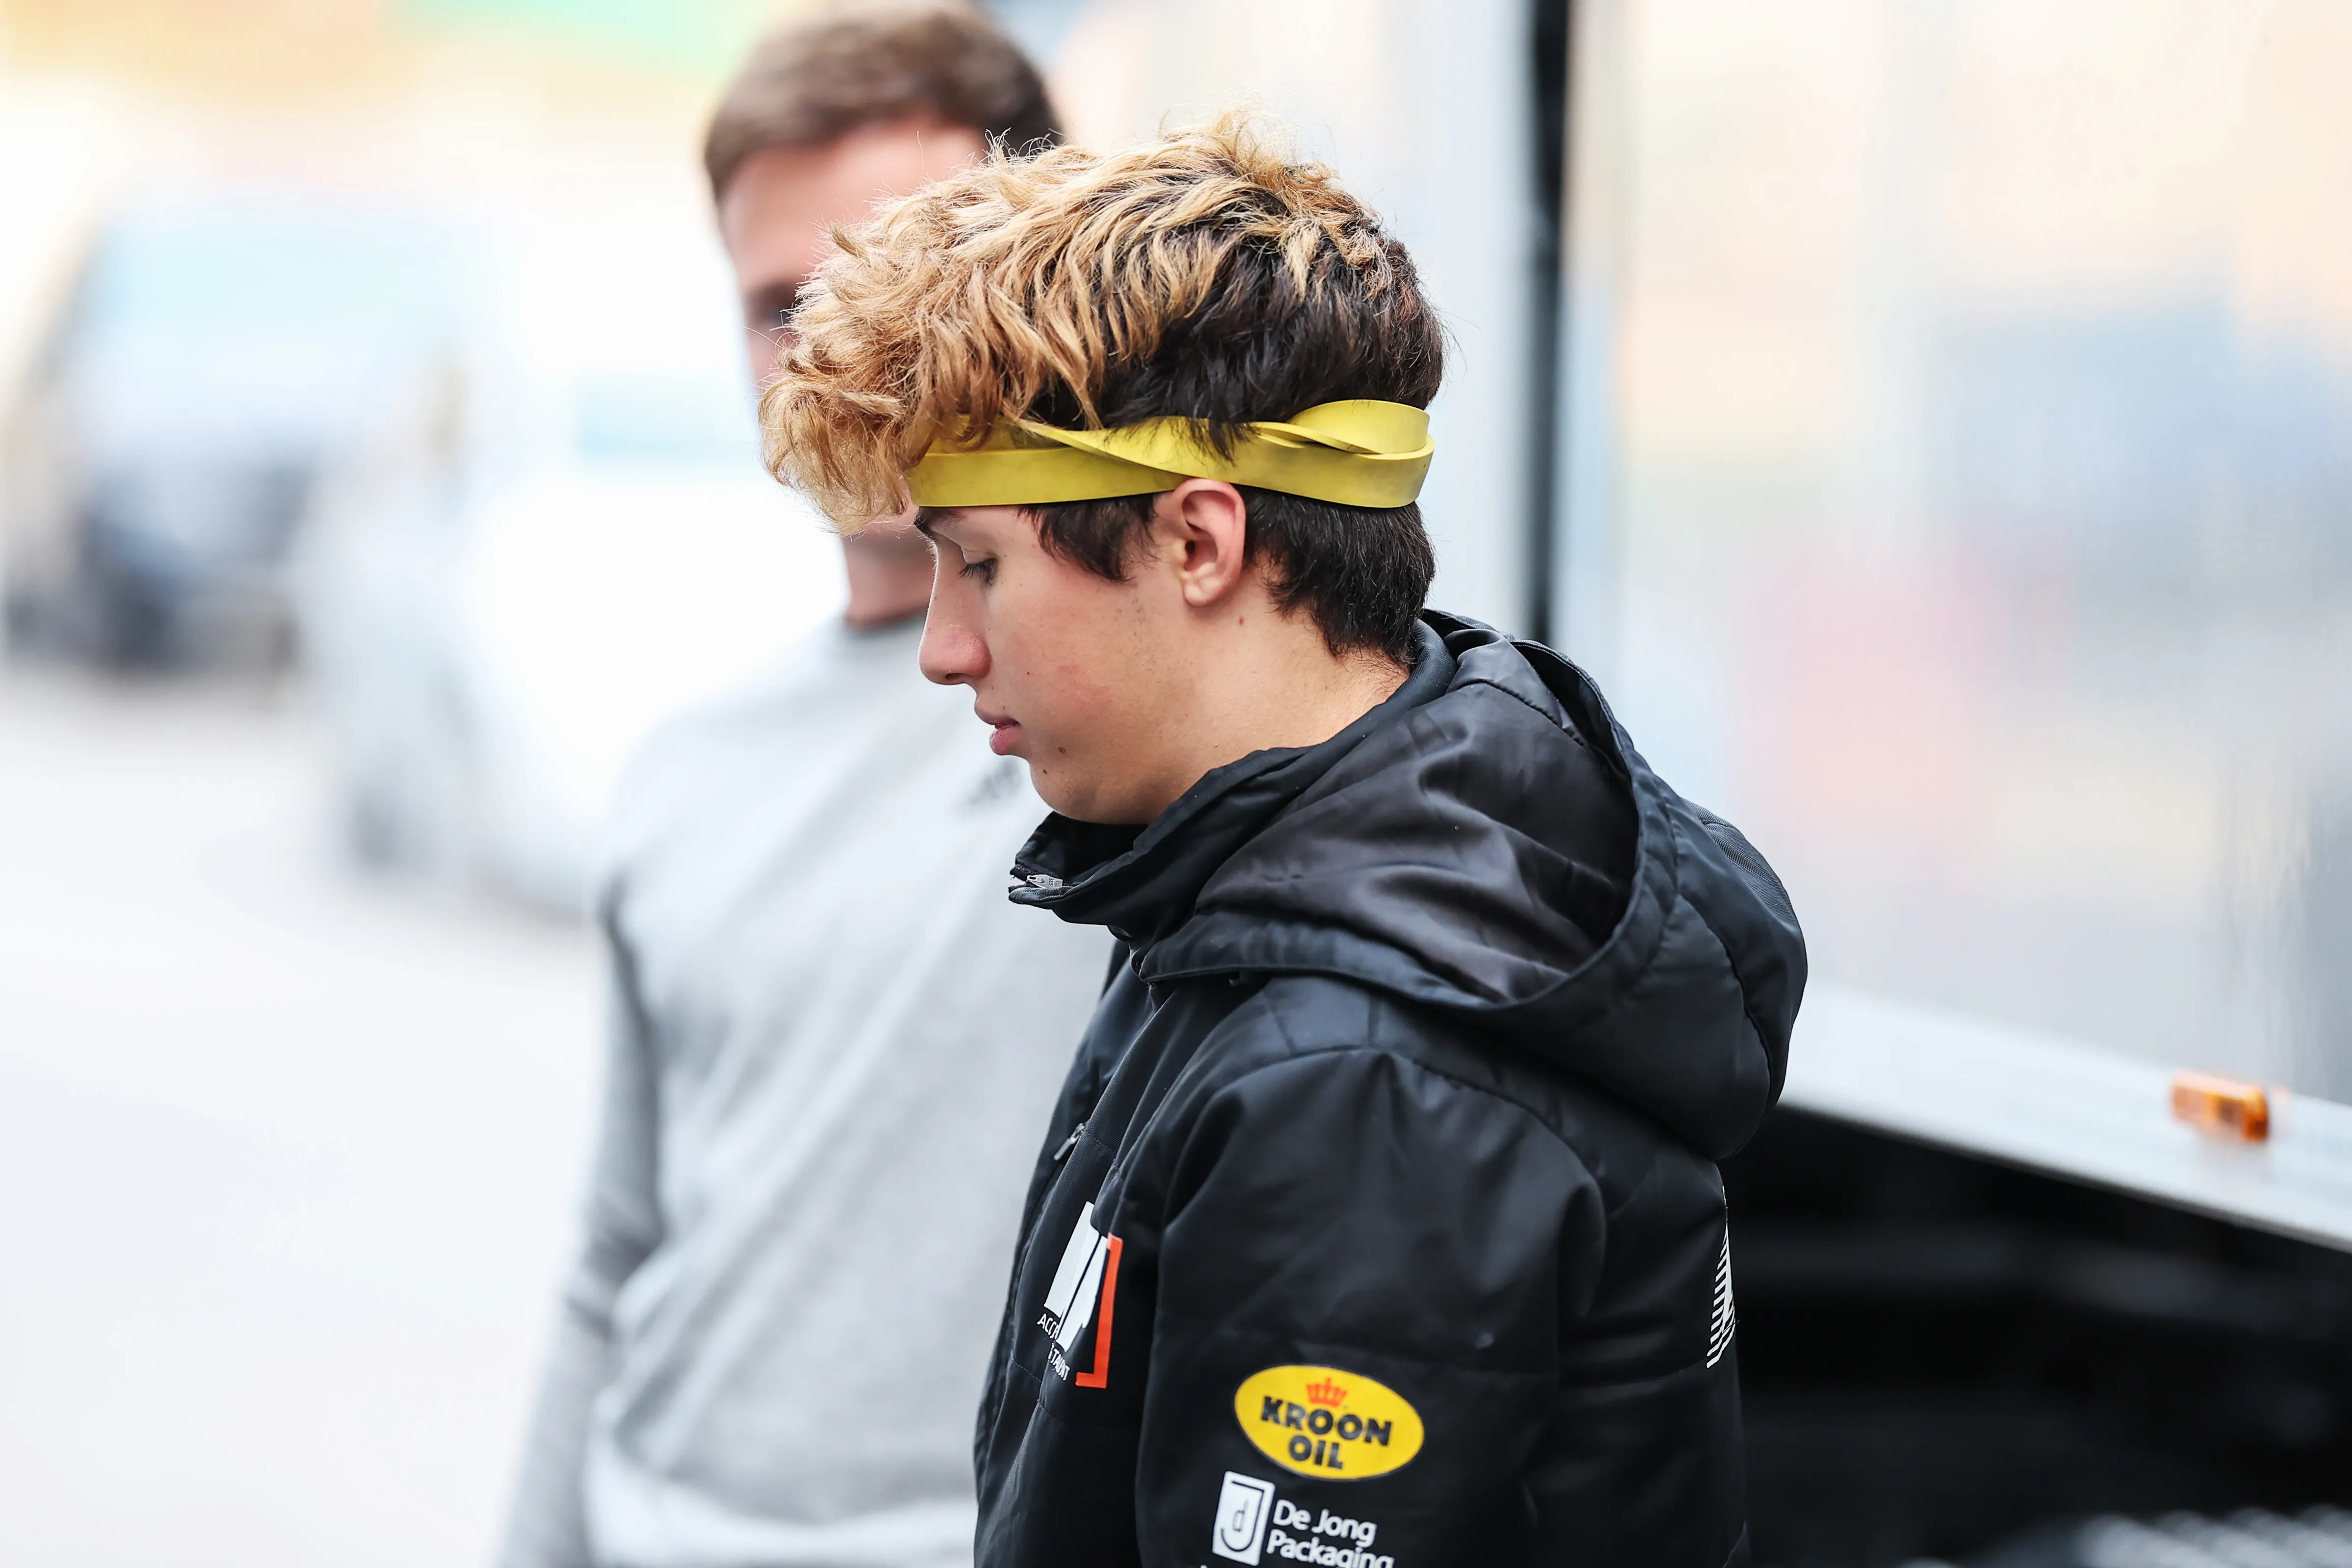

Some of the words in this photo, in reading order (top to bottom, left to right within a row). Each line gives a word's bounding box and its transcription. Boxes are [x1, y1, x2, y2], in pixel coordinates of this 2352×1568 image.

[1261, 1395, 1393, 1447] KROON
[1288, 1435, 1343, 1469] OIL
[1272, 1499, 1311, 1530] De
[1311, 1509, 1377, 1547] Jong
